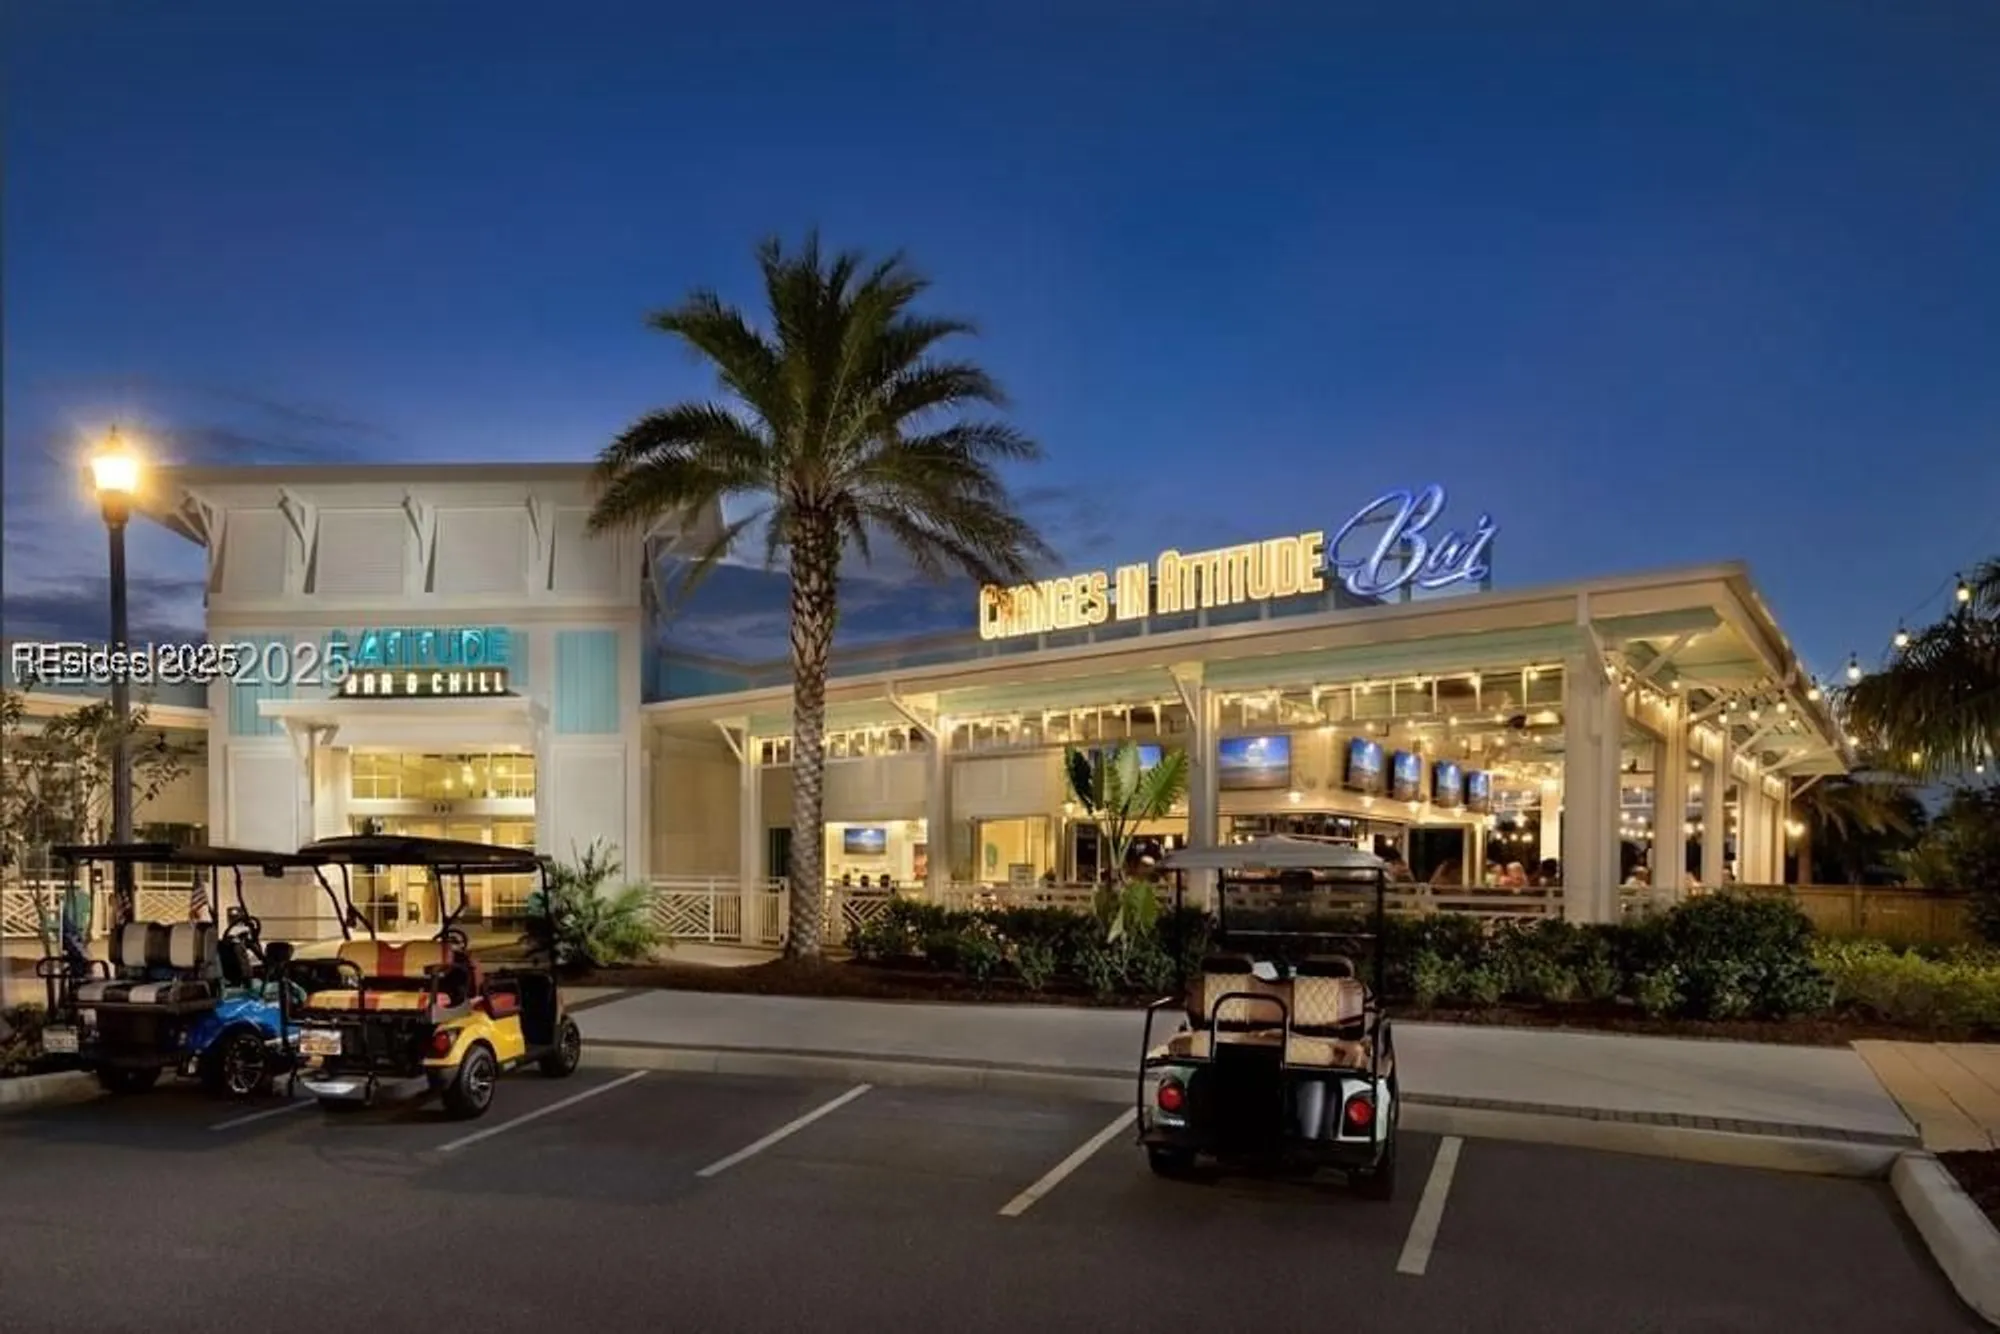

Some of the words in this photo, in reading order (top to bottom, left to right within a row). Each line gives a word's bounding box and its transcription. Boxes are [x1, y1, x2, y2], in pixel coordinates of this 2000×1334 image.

[980, 570, 1108, 640] CHANGES
[1115, 563, 1149, 621] IN
[1156, 531, 1324, 614] ATTITUDE
[431, 670, 505, 694] CHILL
